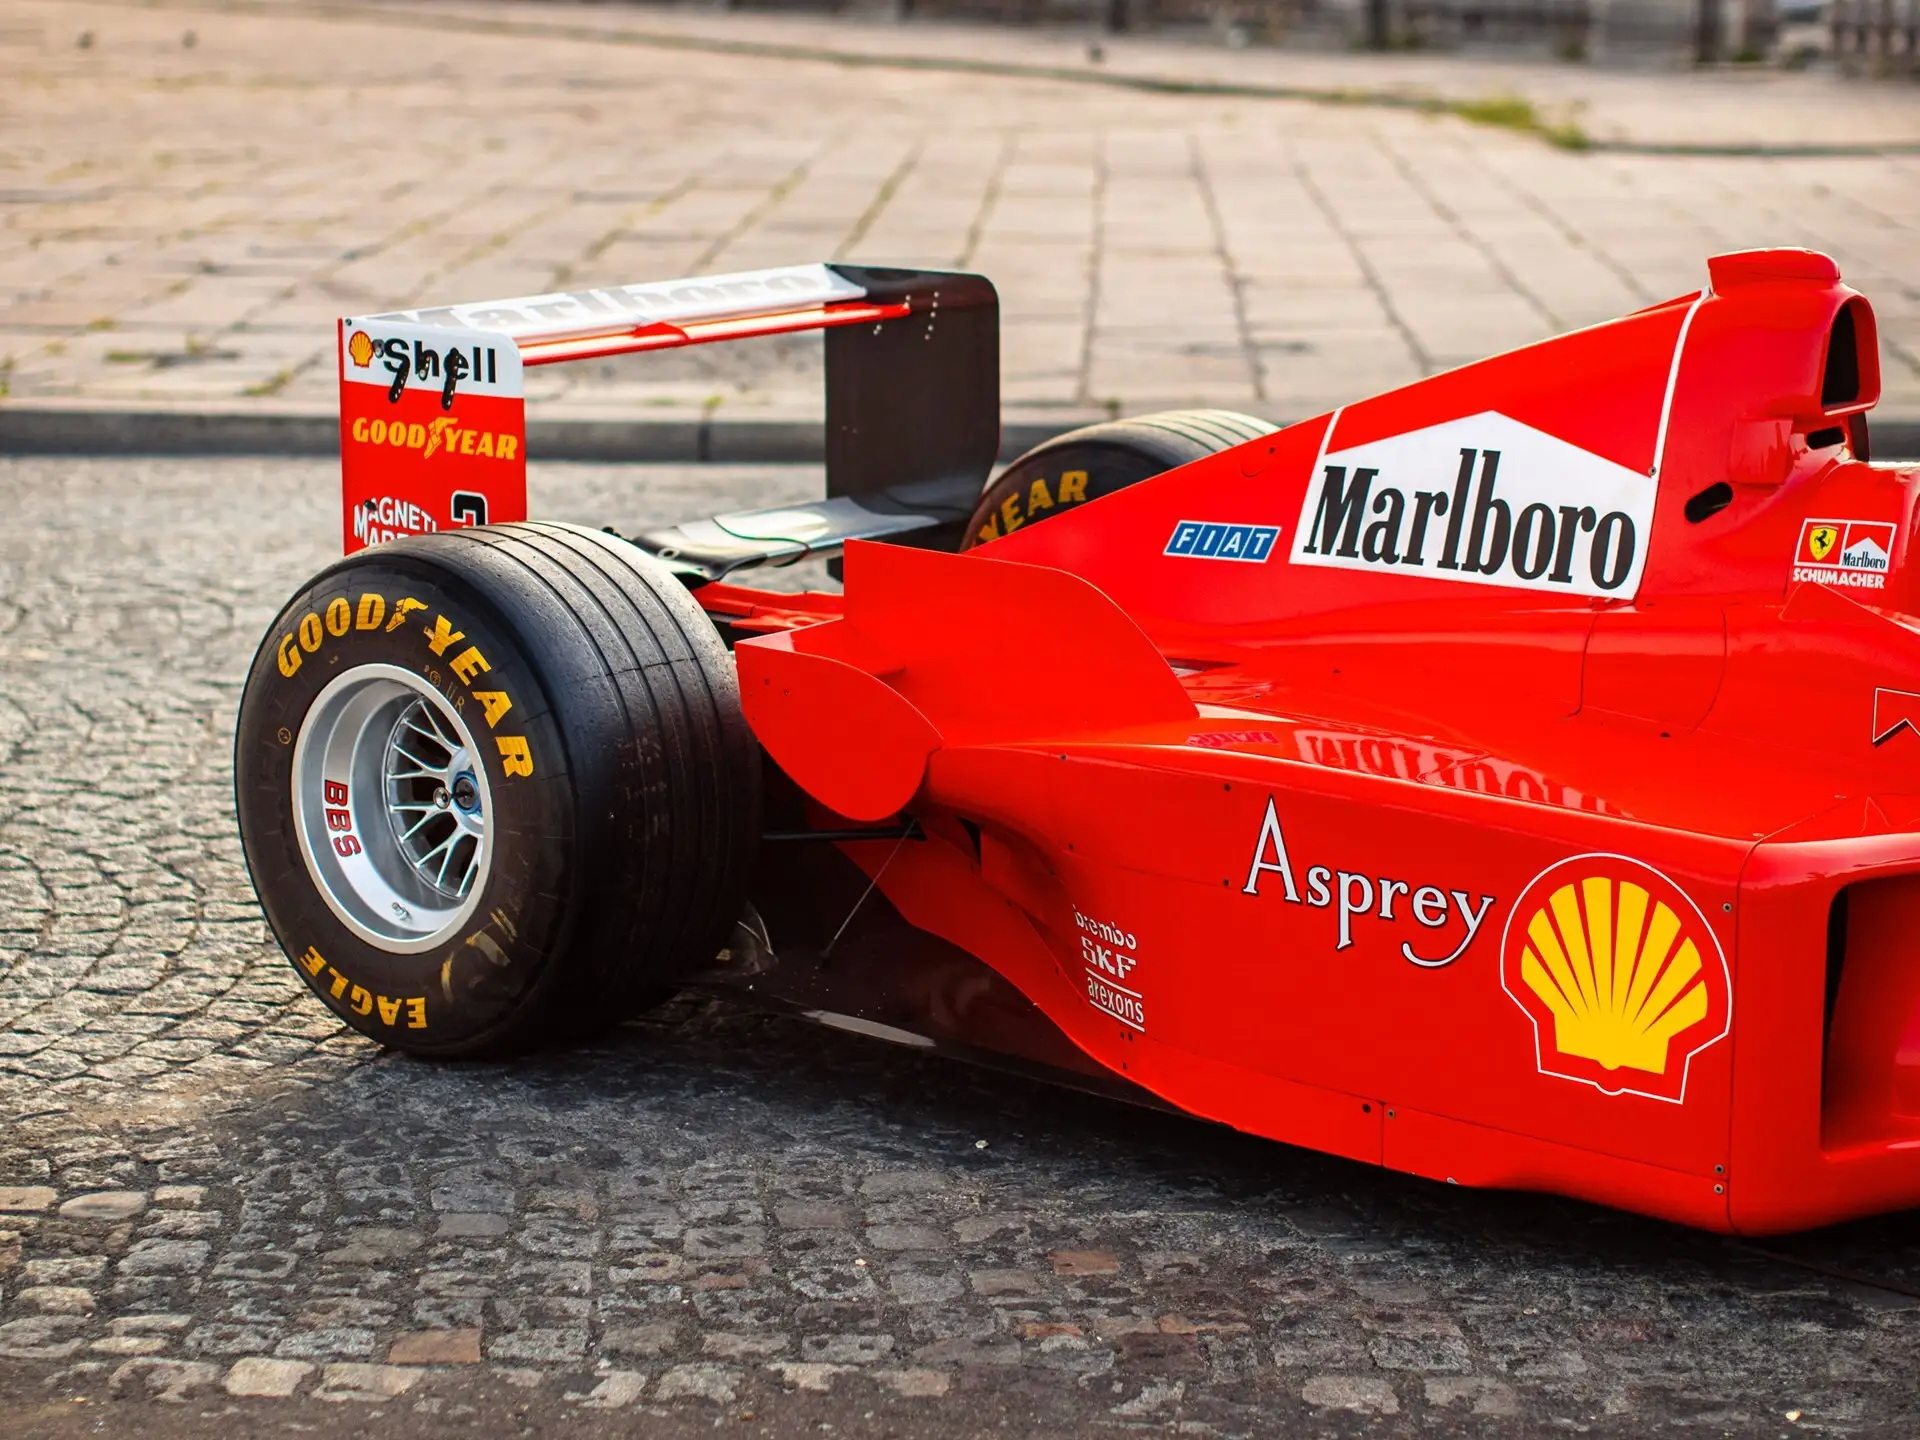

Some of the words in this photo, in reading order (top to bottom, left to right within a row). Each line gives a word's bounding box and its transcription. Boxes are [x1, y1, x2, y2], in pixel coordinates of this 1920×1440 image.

[383, 338, 496, 384] Shell
[1174, 526, 1273, 556] FIAT
[1303, 448, 1636, 590] Marlboro
[1793, 568, 1885, 589] SCHUMACHER
[1841, 551, 1886, 570] Marlboro
[325, 779, 362, 857] BBS
[1242, 795, 1496, 968] Asprey
[1072, 903, 1137, 950] brembo
[1081, 936, 1137, 979] SKF
[300, 945, 428, 1030] EAGLE
[1087, 976, 1144, 1024] arexons
